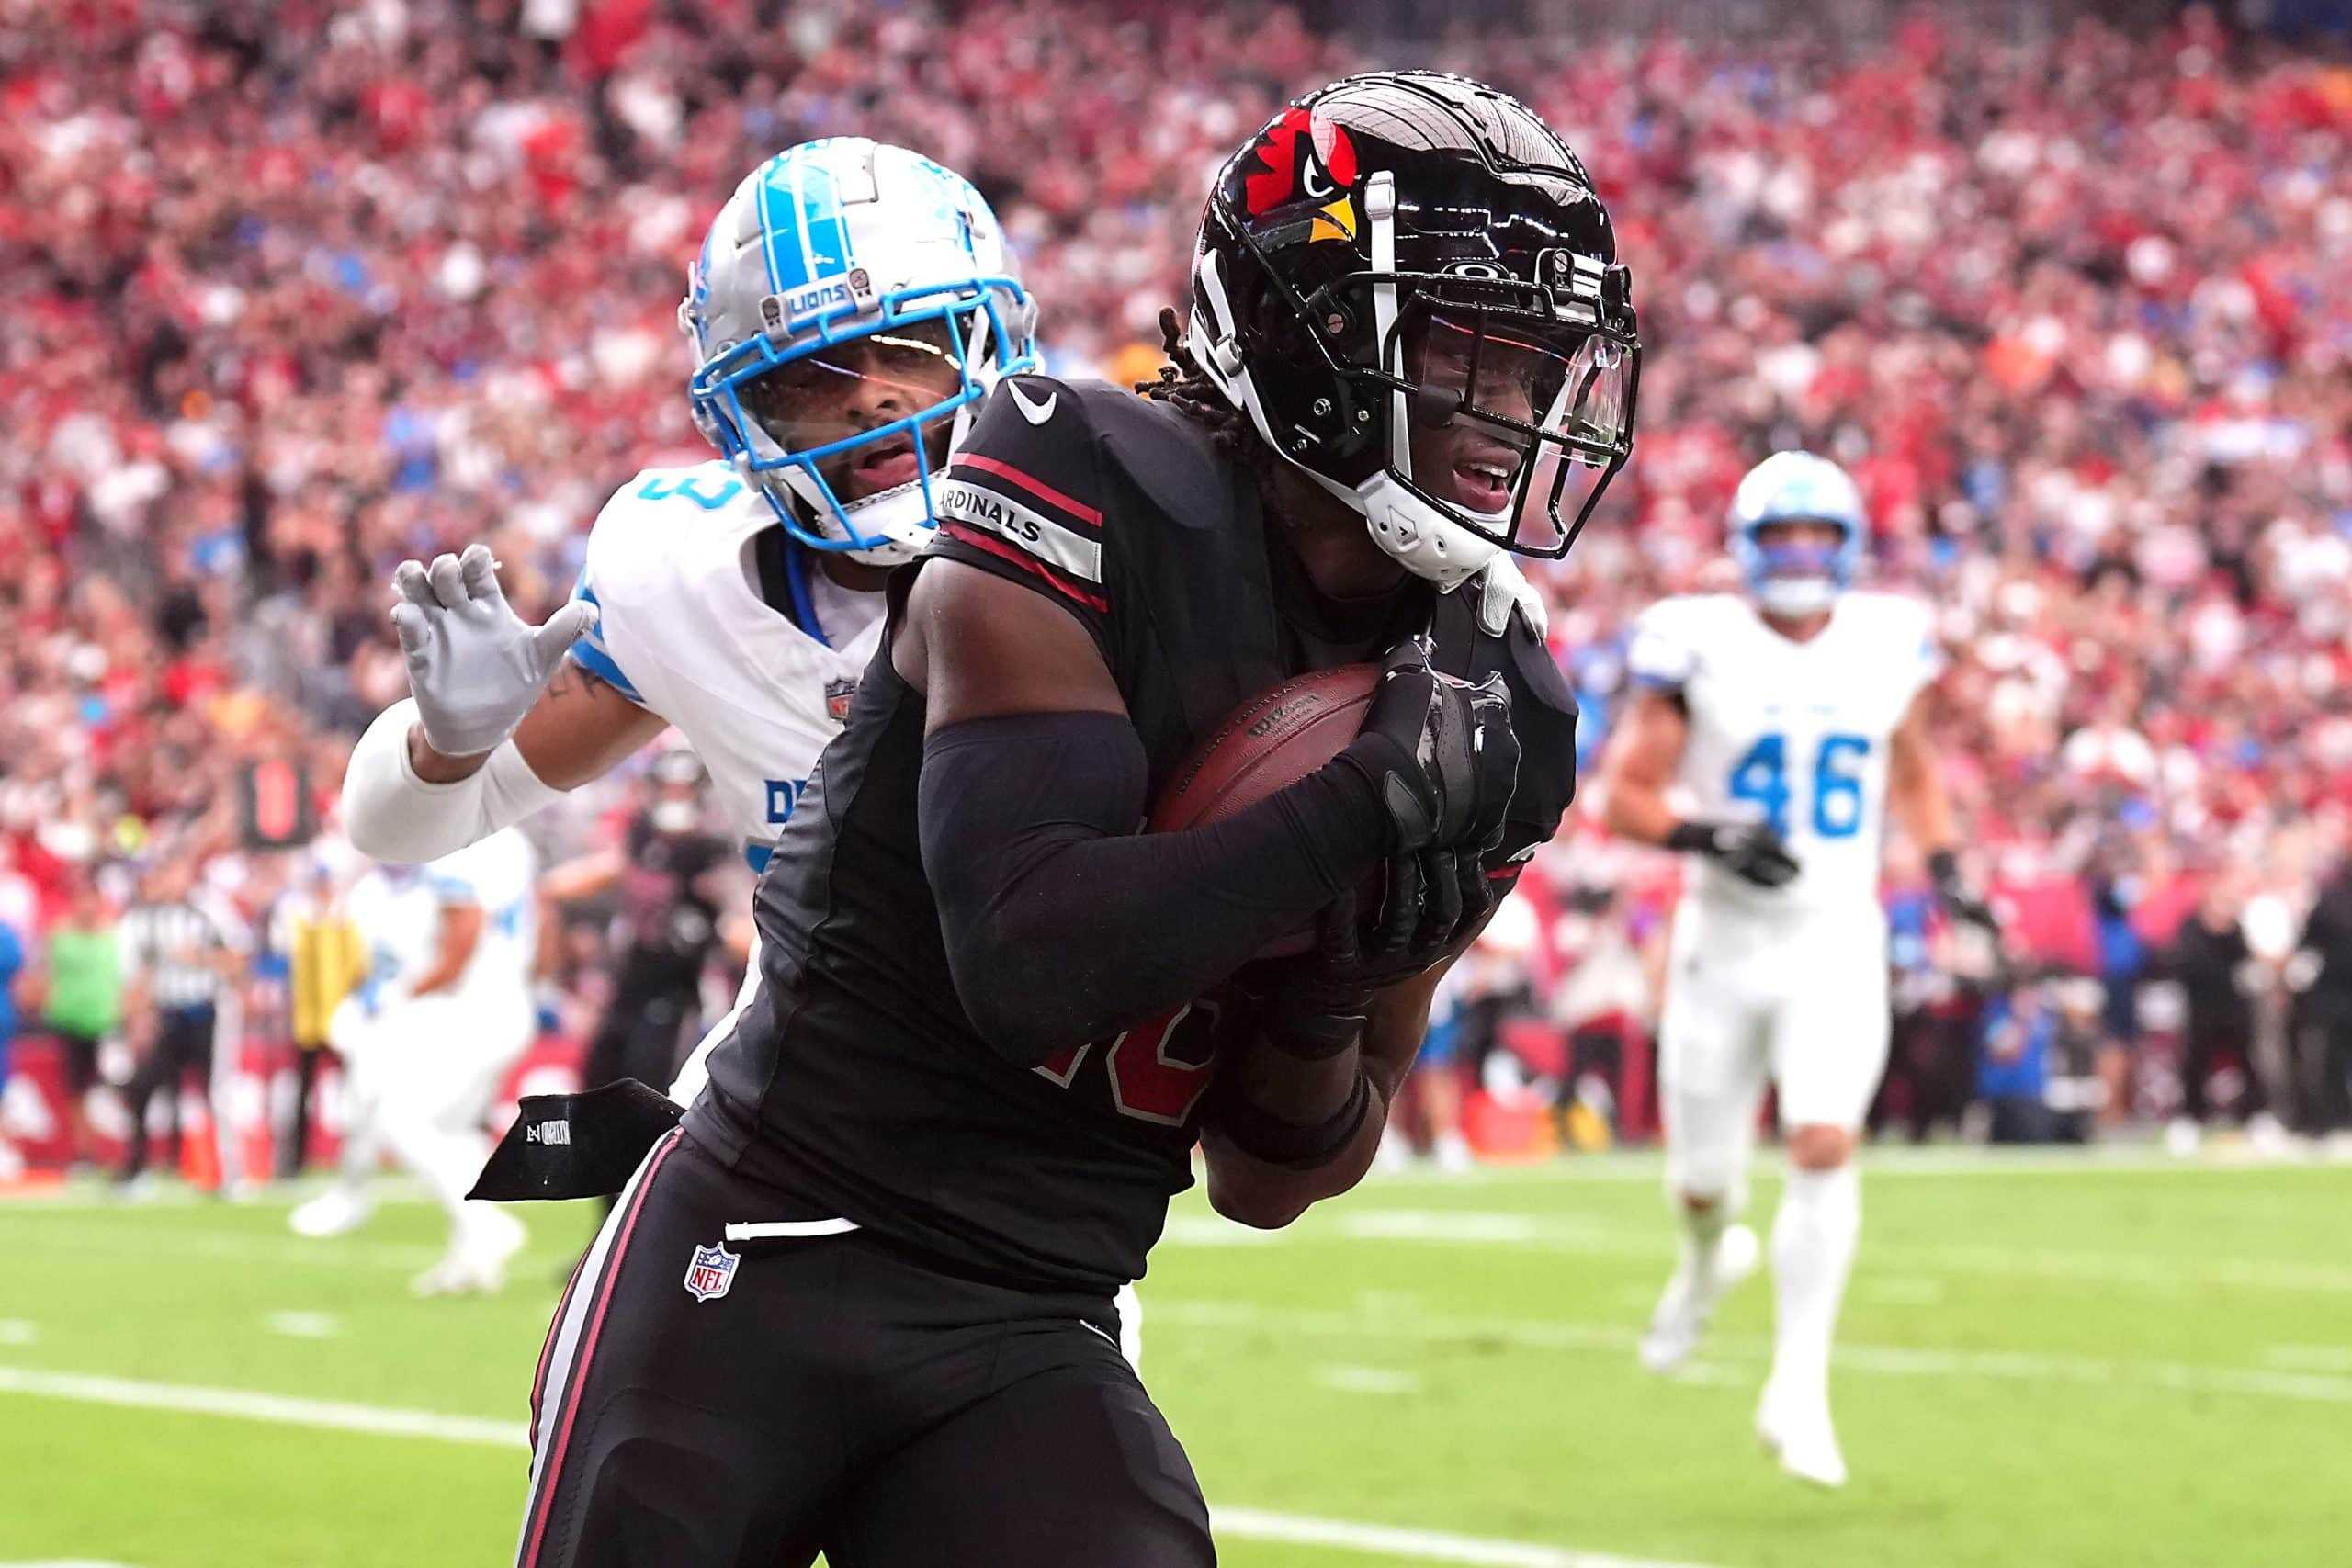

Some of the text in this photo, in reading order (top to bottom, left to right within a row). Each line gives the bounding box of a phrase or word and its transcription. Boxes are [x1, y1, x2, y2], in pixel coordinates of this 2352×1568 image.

[940, 490, 1041, 542] ARDINALS
[1729, 732, 1871, 839] 46
[692, 1267, 723, 1291] NFL
